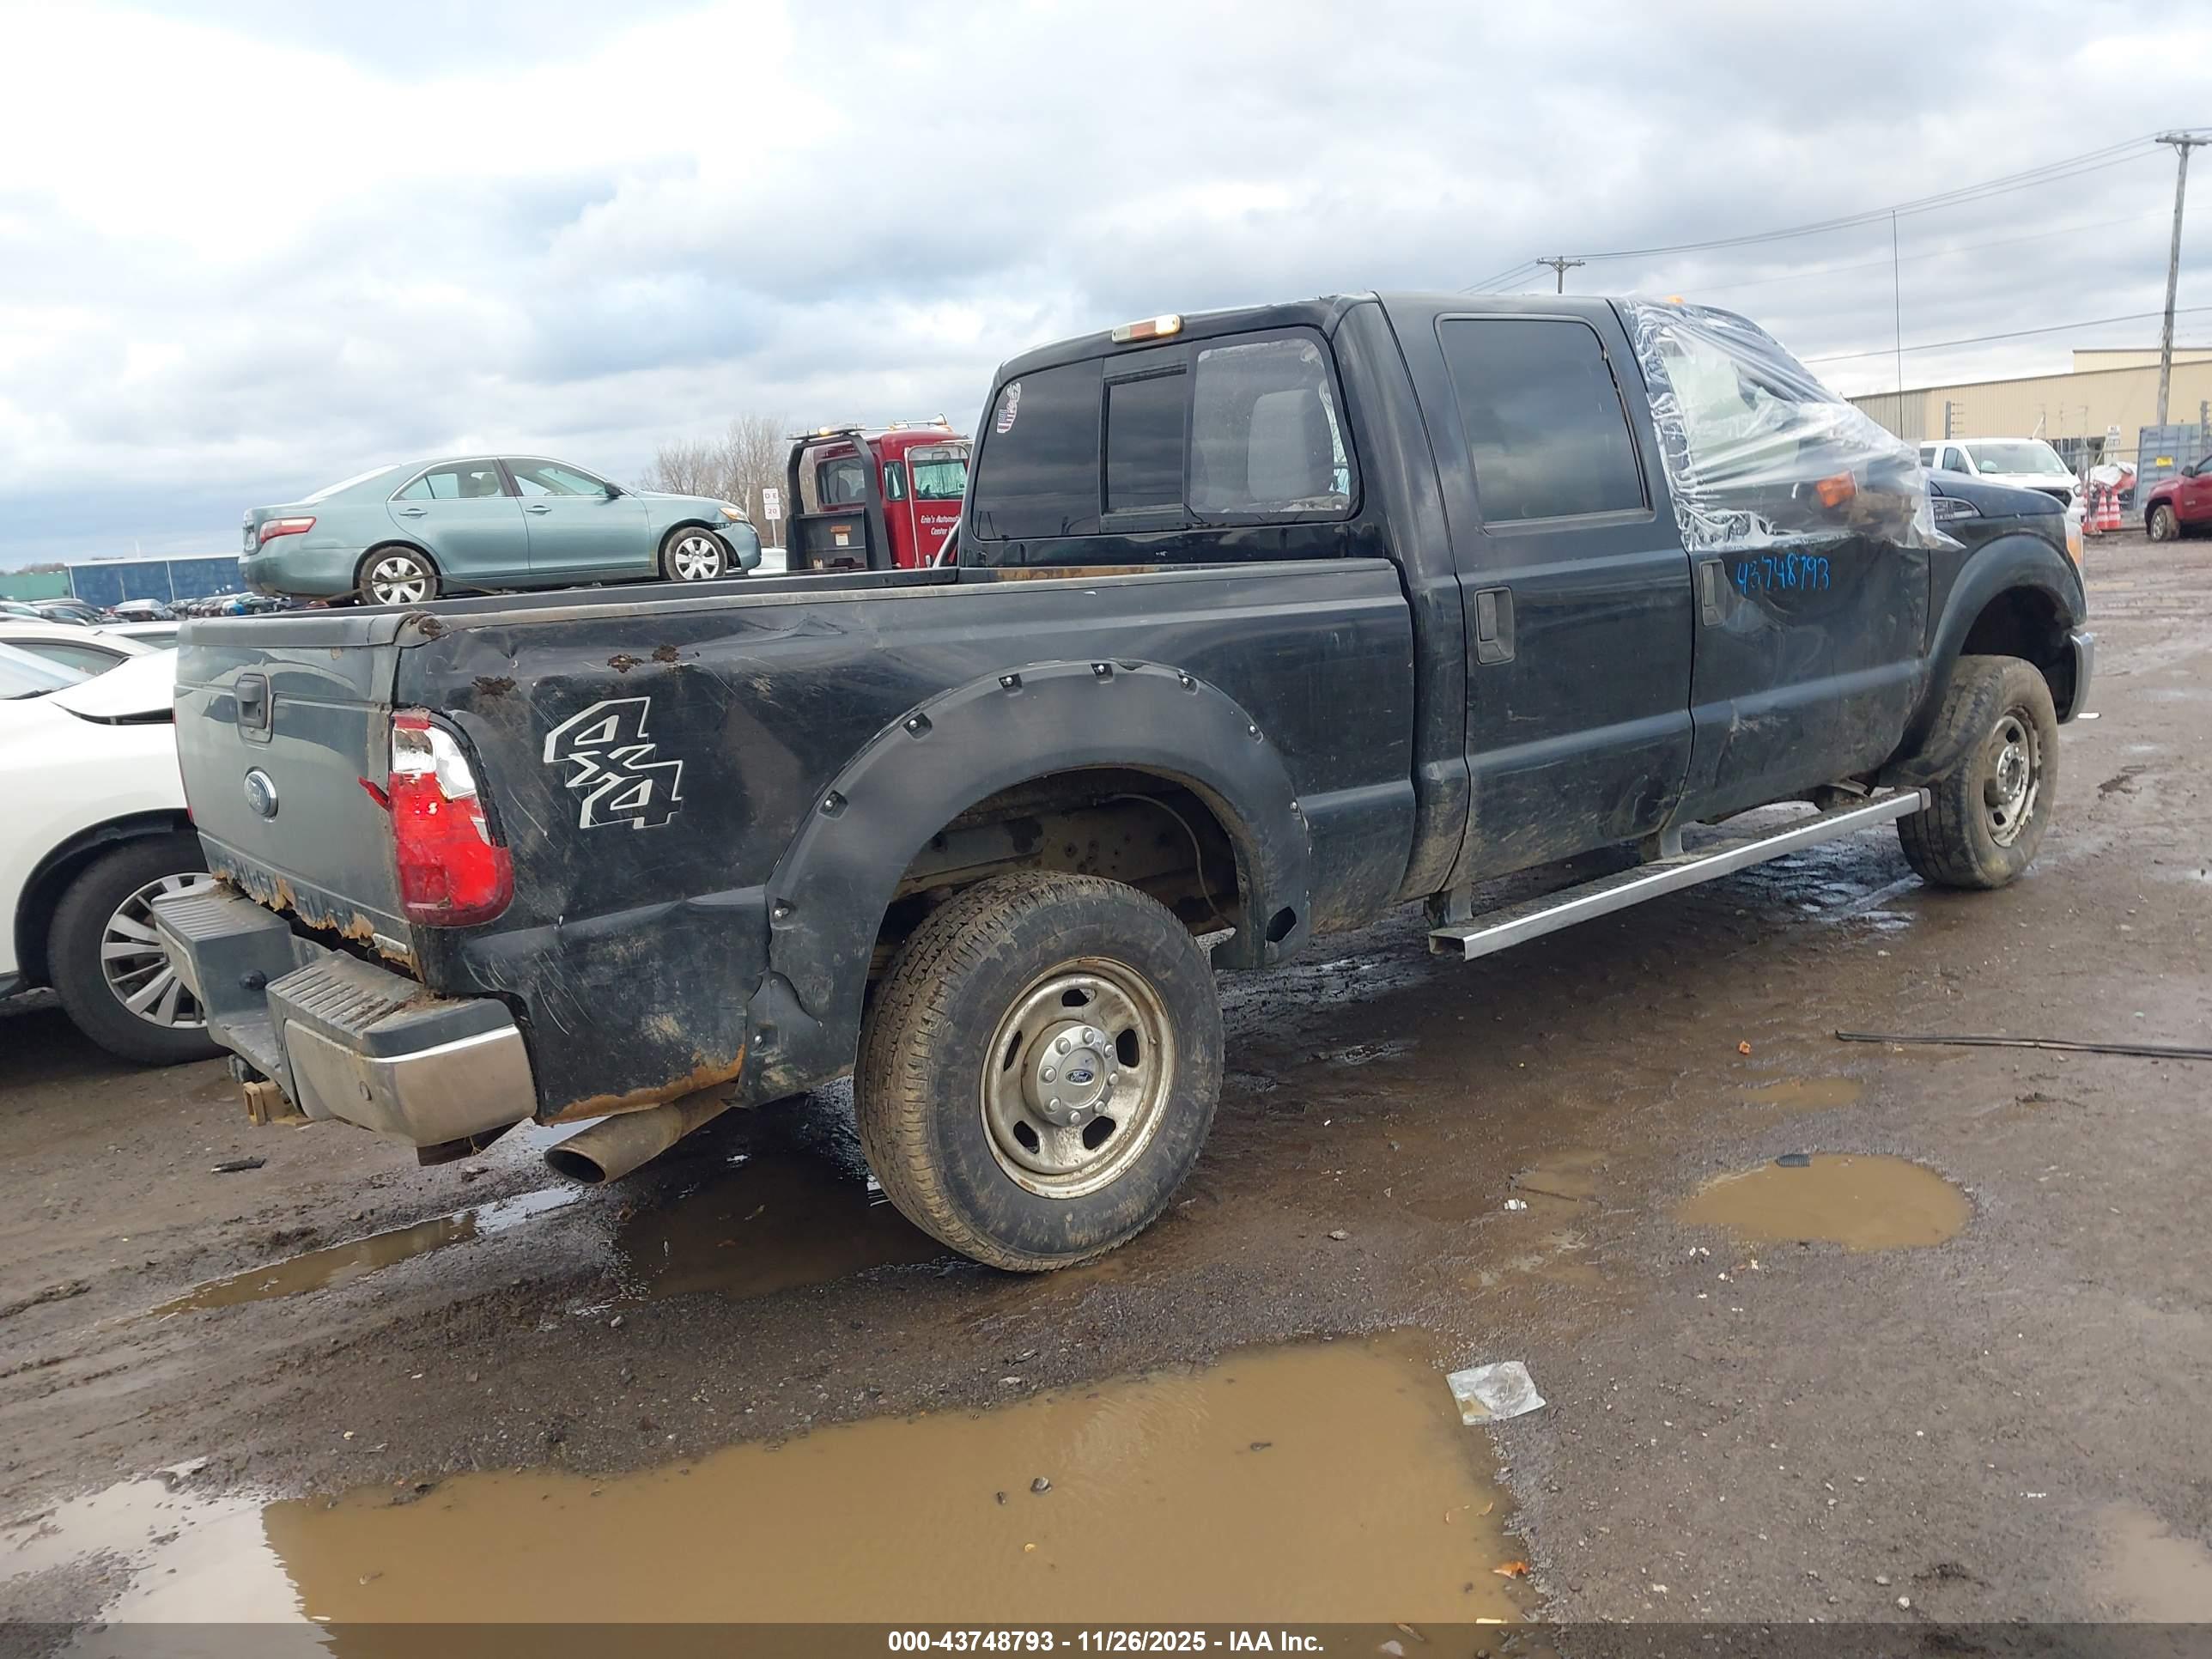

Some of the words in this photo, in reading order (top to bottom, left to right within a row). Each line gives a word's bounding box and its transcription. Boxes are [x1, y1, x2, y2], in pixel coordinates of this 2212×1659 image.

[936, 514, 961, 524] Automoti
[931, 526, 948, 536] Center
[1735, 553, 1831, 595] 43748793
